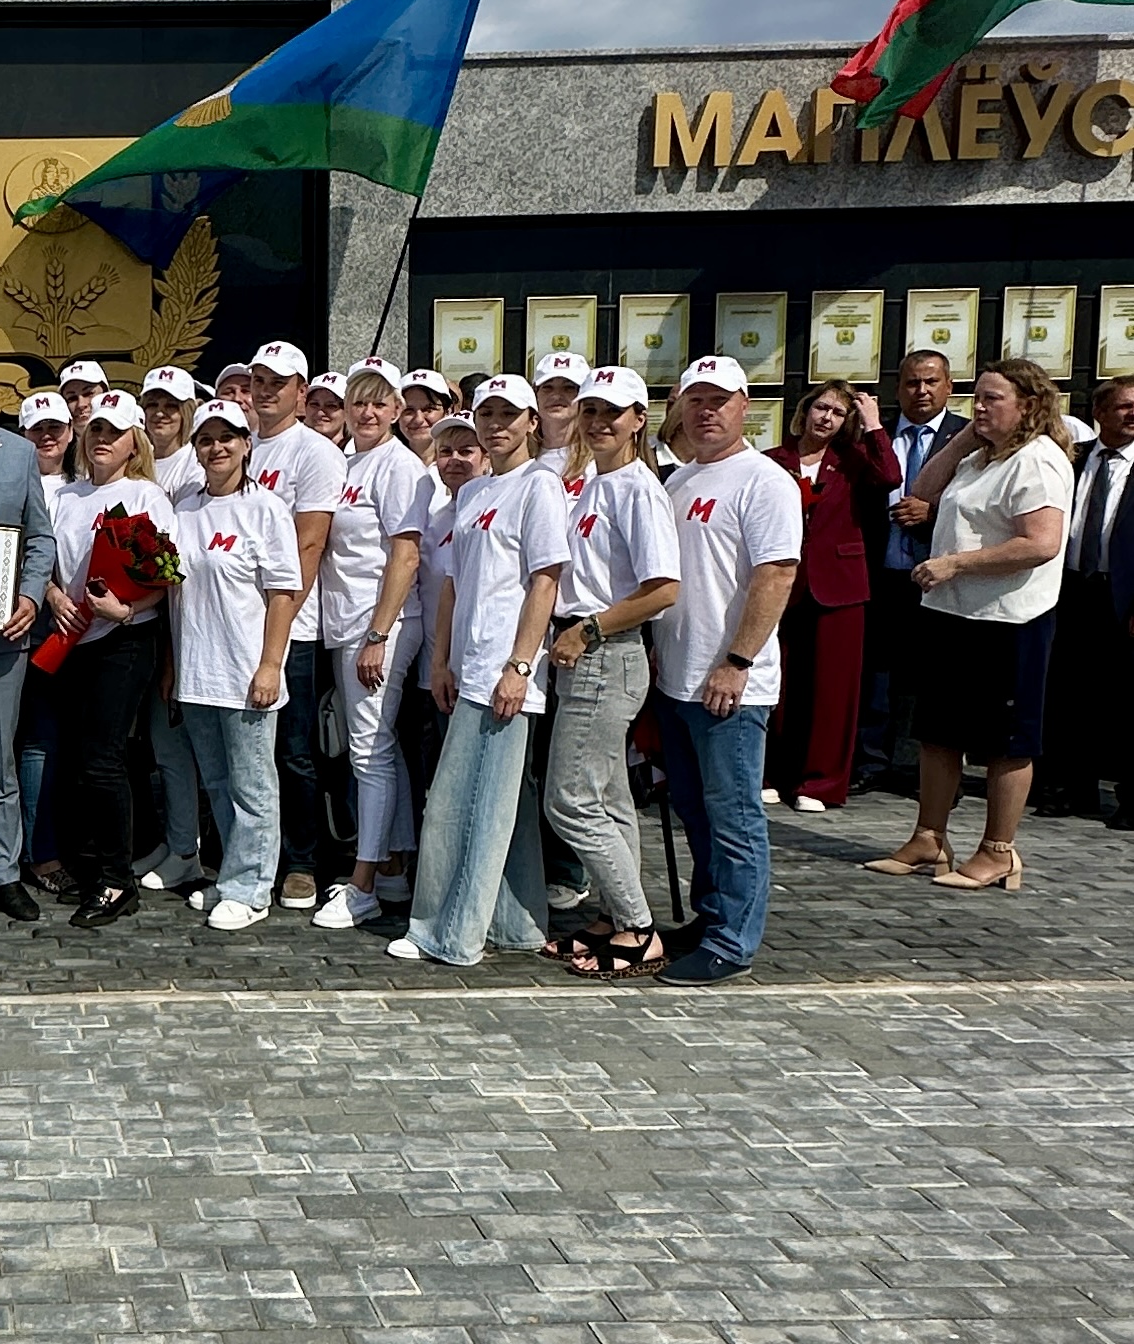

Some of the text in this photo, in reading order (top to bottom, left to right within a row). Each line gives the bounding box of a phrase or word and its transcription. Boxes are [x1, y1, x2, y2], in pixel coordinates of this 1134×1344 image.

[265, 345, 282, 355] М
[365, 358, 382, 367] М
[553, 357, 571, 368] М
[697, 360, 717, 372] М
[159, 369, 174, 380] М
[321, 374, 338, 384] М
[412, 373, 427, 381] М
[594, 370, 615, 383] М
[489, 379, 507, 389] М
[35, 397, 51, 409] М
[100, 394, 121, 407] М
[208, 401, 225, 412] М
[258, 469, 281, 491] М
[341, 486, 361, 505] М
[686, 497, 717, 524] М
[208, 532, 238, 552] М
